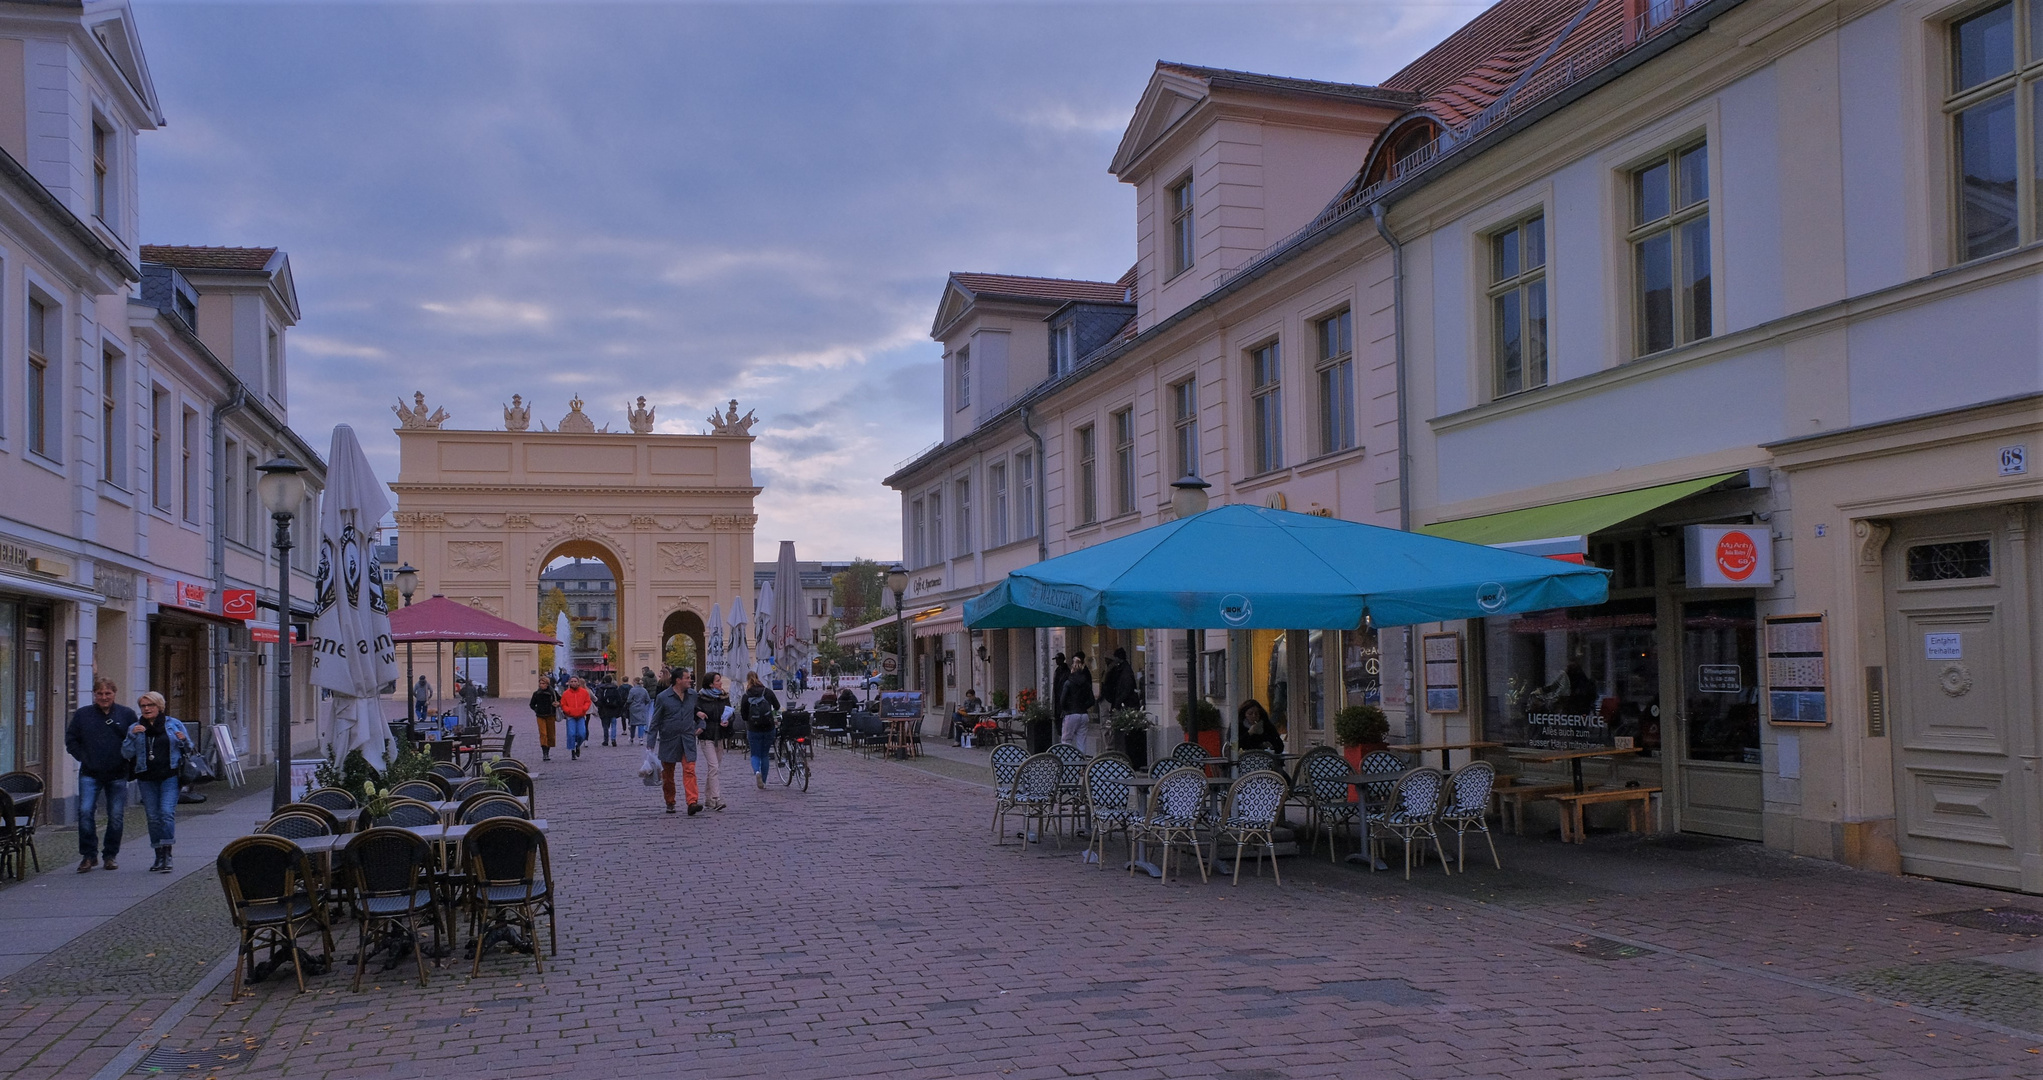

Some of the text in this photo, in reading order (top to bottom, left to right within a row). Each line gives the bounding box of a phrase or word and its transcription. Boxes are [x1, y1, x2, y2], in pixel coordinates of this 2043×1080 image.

[2001, 447, 2023, 466] 68
[1528, 712, 1605, 728] LIEFERSERVICE
[1541, 726, 1590, 738] Alles auch zum
[1528, 738, 1550, 747] ausser
[1550, 739, 1567, 749] Haus
[1568, 740, 1605, 750] mitnehmen
